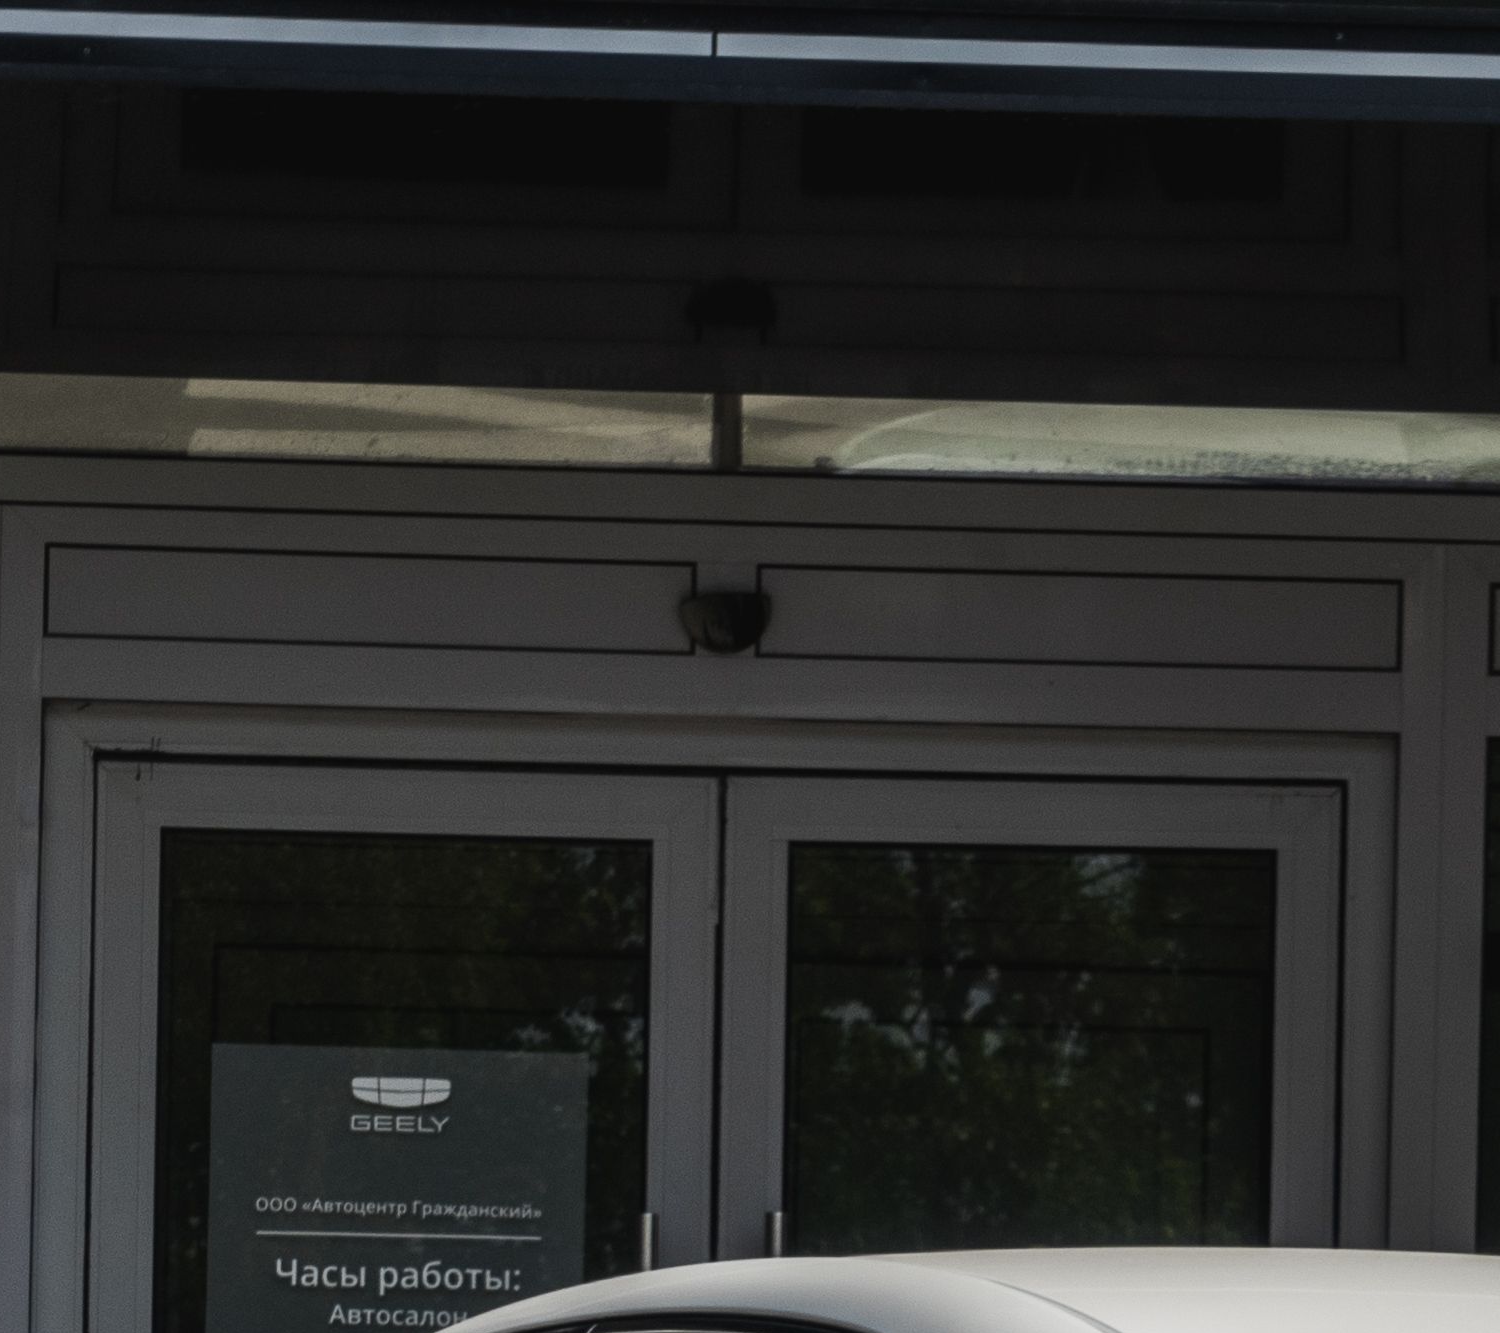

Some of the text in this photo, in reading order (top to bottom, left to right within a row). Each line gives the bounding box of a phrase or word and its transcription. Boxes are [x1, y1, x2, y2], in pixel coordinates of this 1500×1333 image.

[350, 1114, 449, 1133] GEELY
[255, 1196, 542, 1219] ООО «Автоцентр Гражданский»
[275, 1258, 521, 1296] Часы работы:
